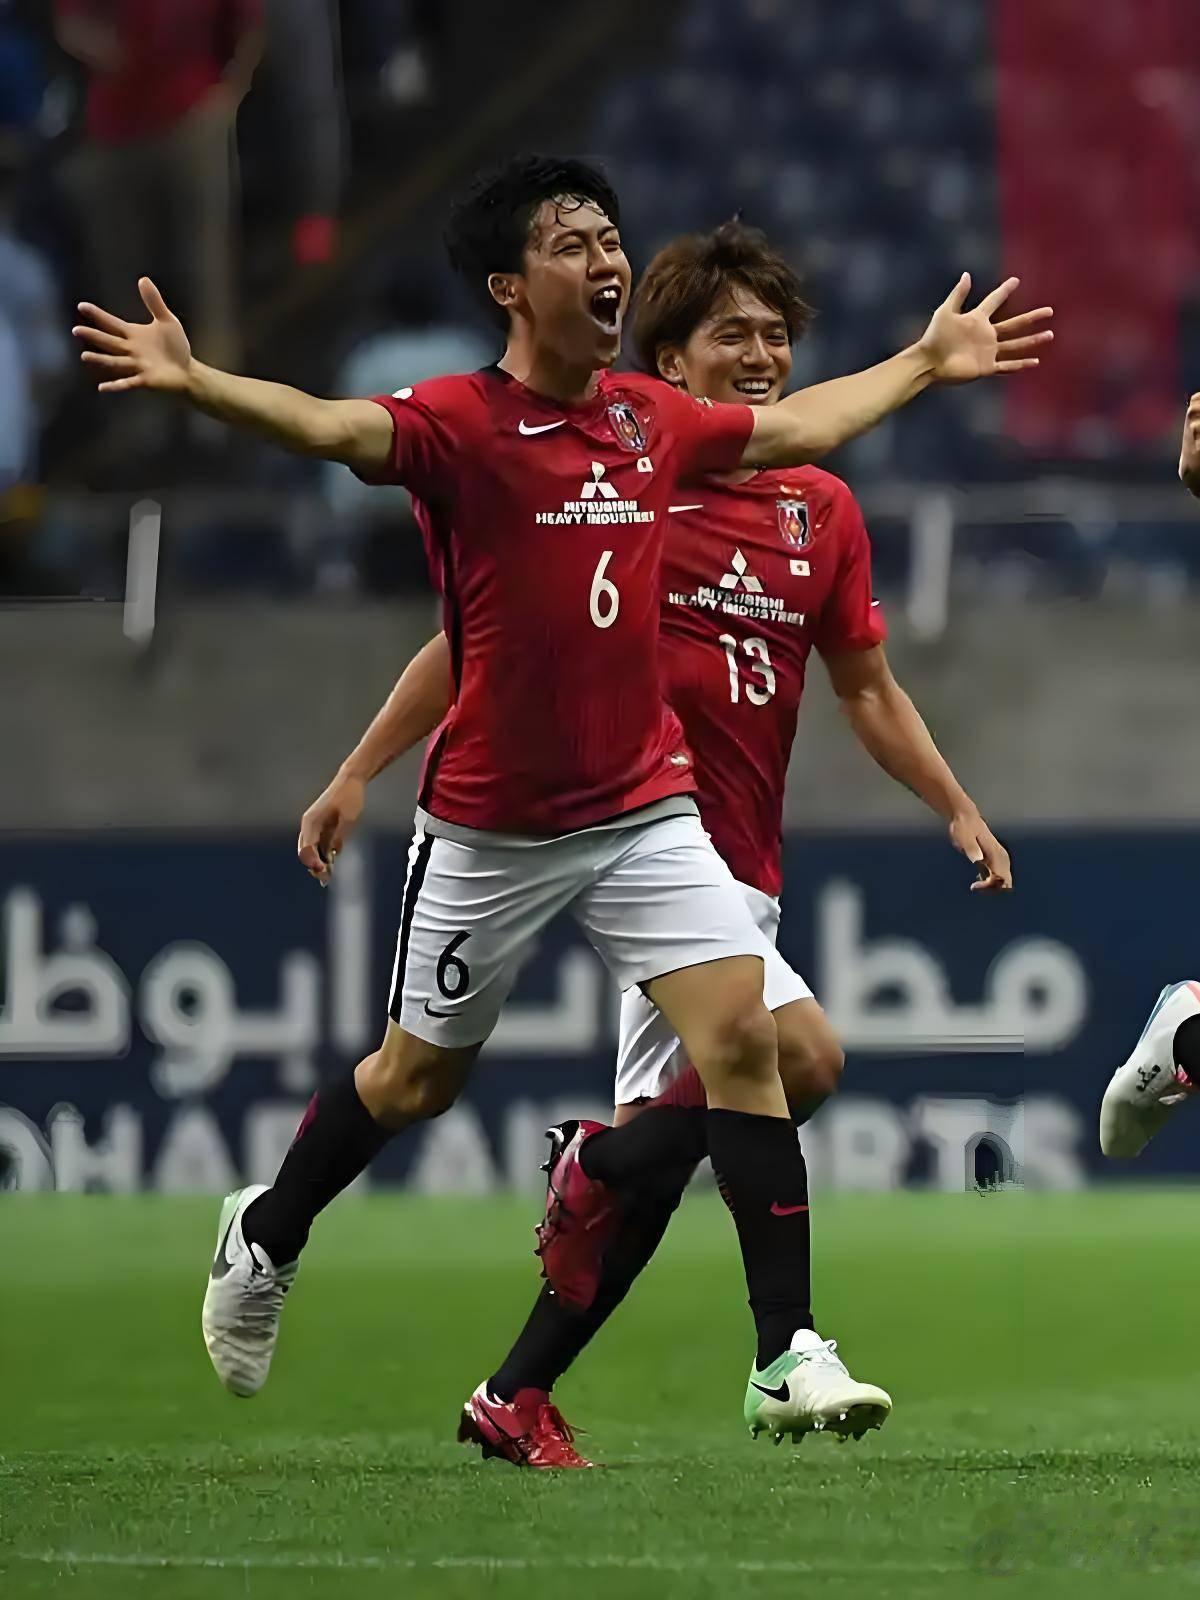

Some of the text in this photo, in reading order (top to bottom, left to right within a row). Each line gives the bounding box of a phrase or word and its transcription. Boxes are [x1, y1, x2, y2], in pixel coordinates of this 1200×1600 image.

[535, 512, 583, 525] HEAVY
[589, 550, 620, 629] 6
[718, 633, 776, 706] 13
[436, 930, 471, 999] 6
